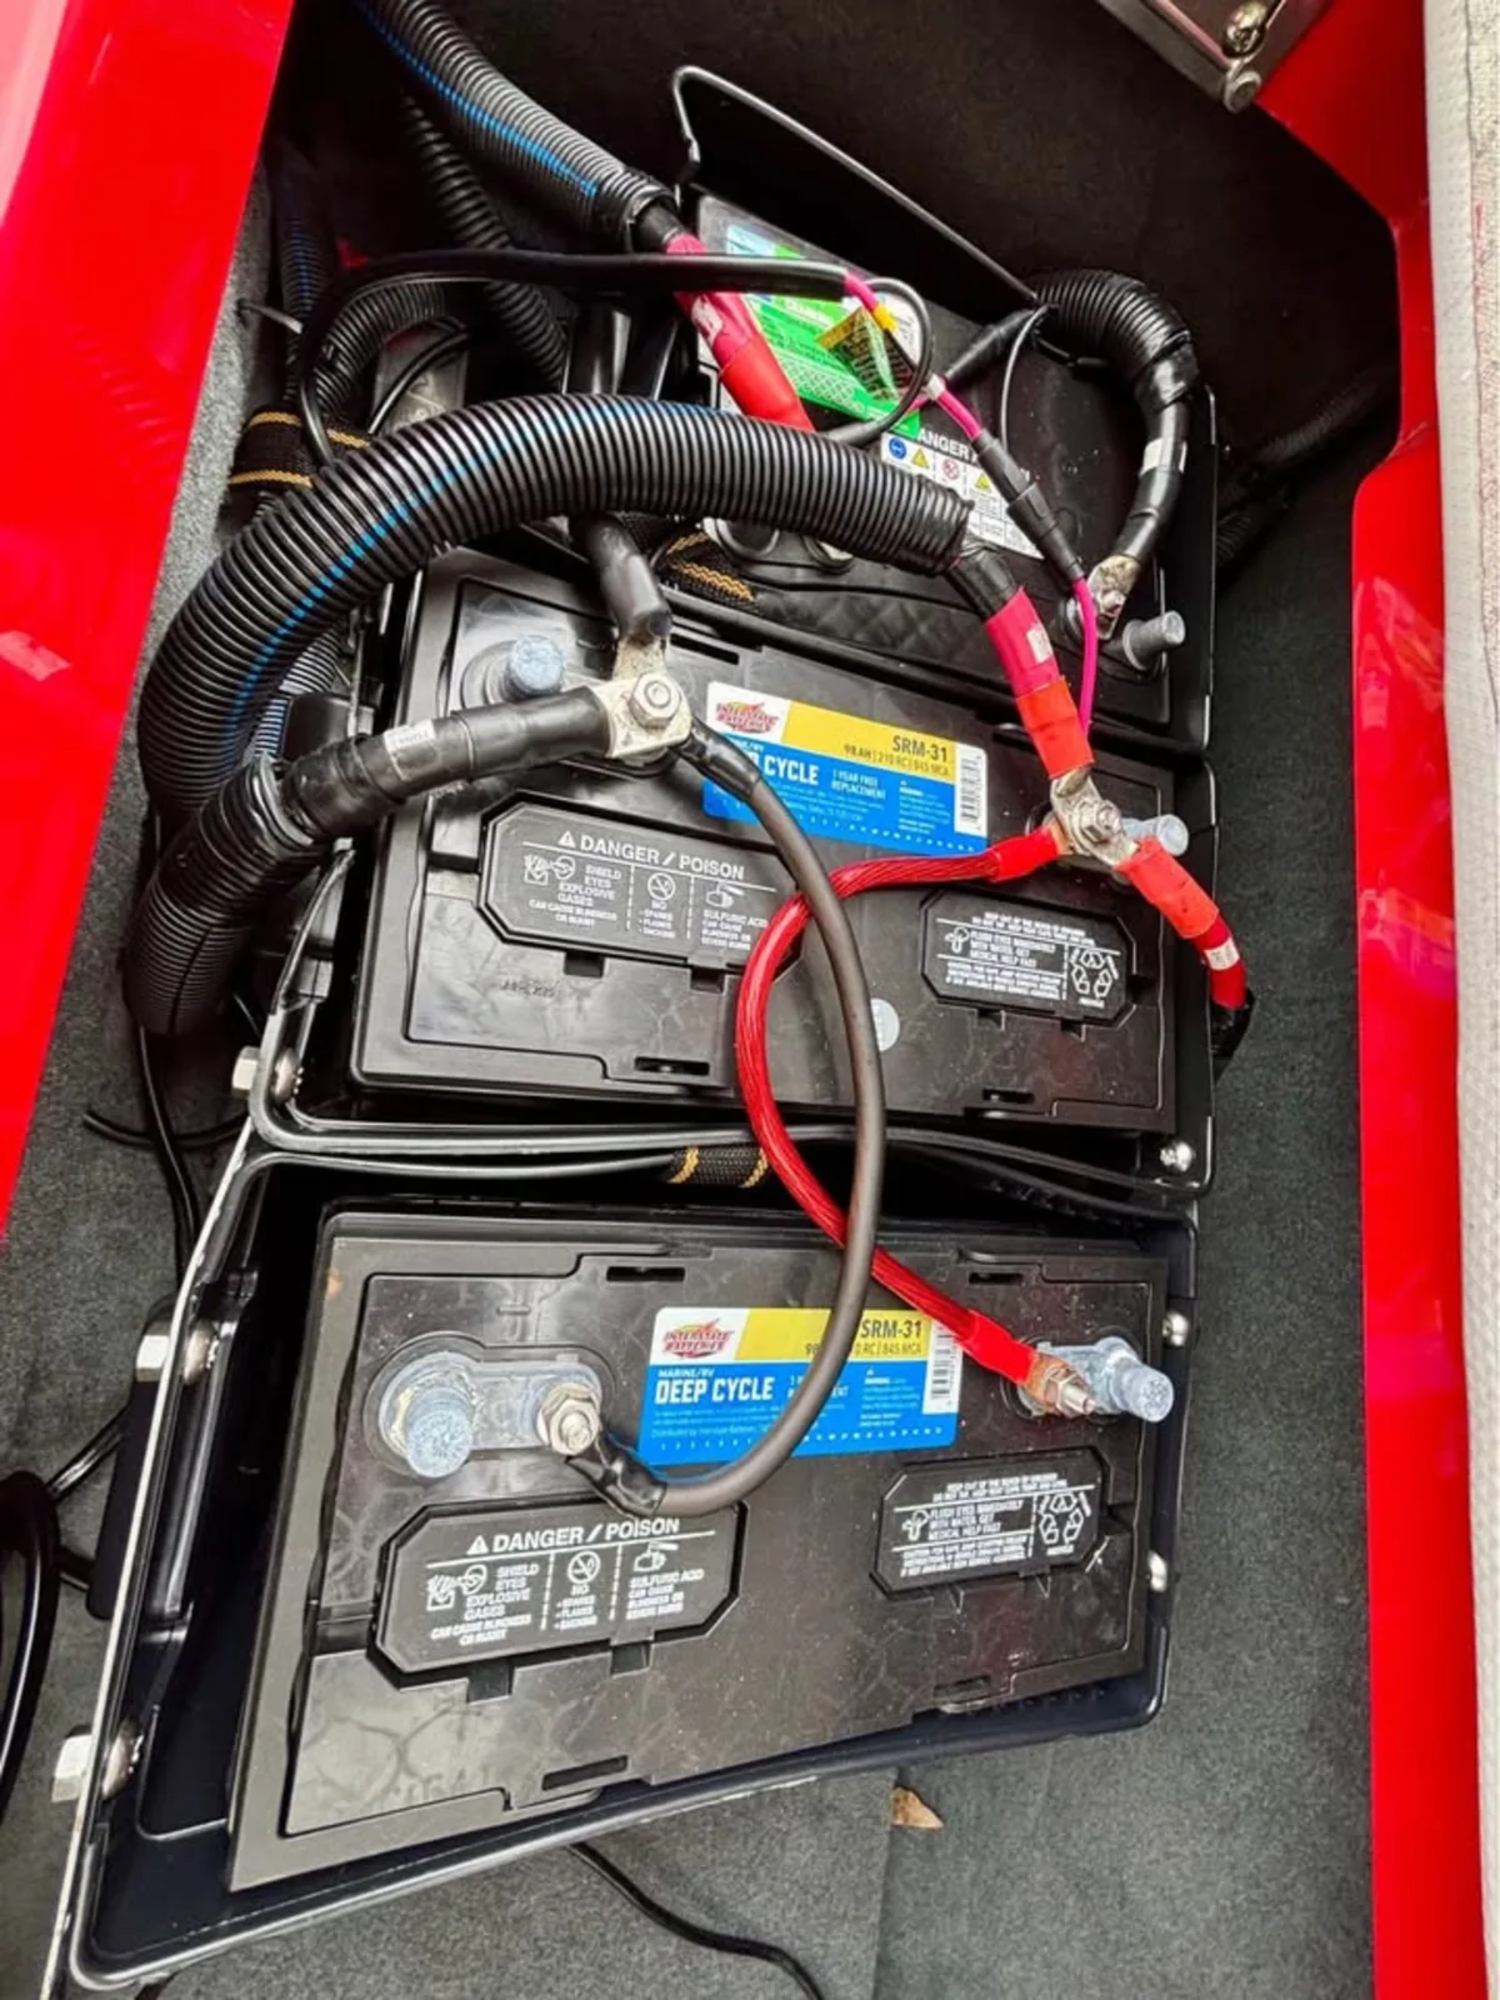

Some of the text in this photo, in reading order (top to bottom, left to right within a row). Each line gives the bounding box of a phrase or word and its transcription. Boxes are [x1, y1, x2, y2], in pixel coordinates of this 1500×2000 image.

[919, 428, 970, 458] ANGER
[891, 733, 948, 763] SRM-31
[764, 755, 820, 786] CYCLE
[831, 780, 887, 800] REPLACEMENT
[580, 834, 660, 865] DANGER
[678, 854, 745, 880] POISON
[584, 875, 611, 888] EYES
[585, 864, 622, 880] SHIELD
[558, 882, 616, 900] EXPLOSIVE
[651, 900, 668, 911] NO
[664, 1329, 735, 1342] INTERSTATE
[860, 1318, 922, 1339] SRM-31
[658, 1368, 716, 1379] MARINE/RV
[654, 1378, 708, 1406] DEEP
[712, 1376, 775, 1402] CYCLE
[492, 1526, 584, 1553] DANGER
[604, 1518, 680, 1541] POISON
[496, 1563, 540, 1579] SHIELD
[495, 1576, 528, 1592] EYES
[571, 1584, 591, 1597] NO
[465, 1587, 531, 1609] EXPLOSIVE
